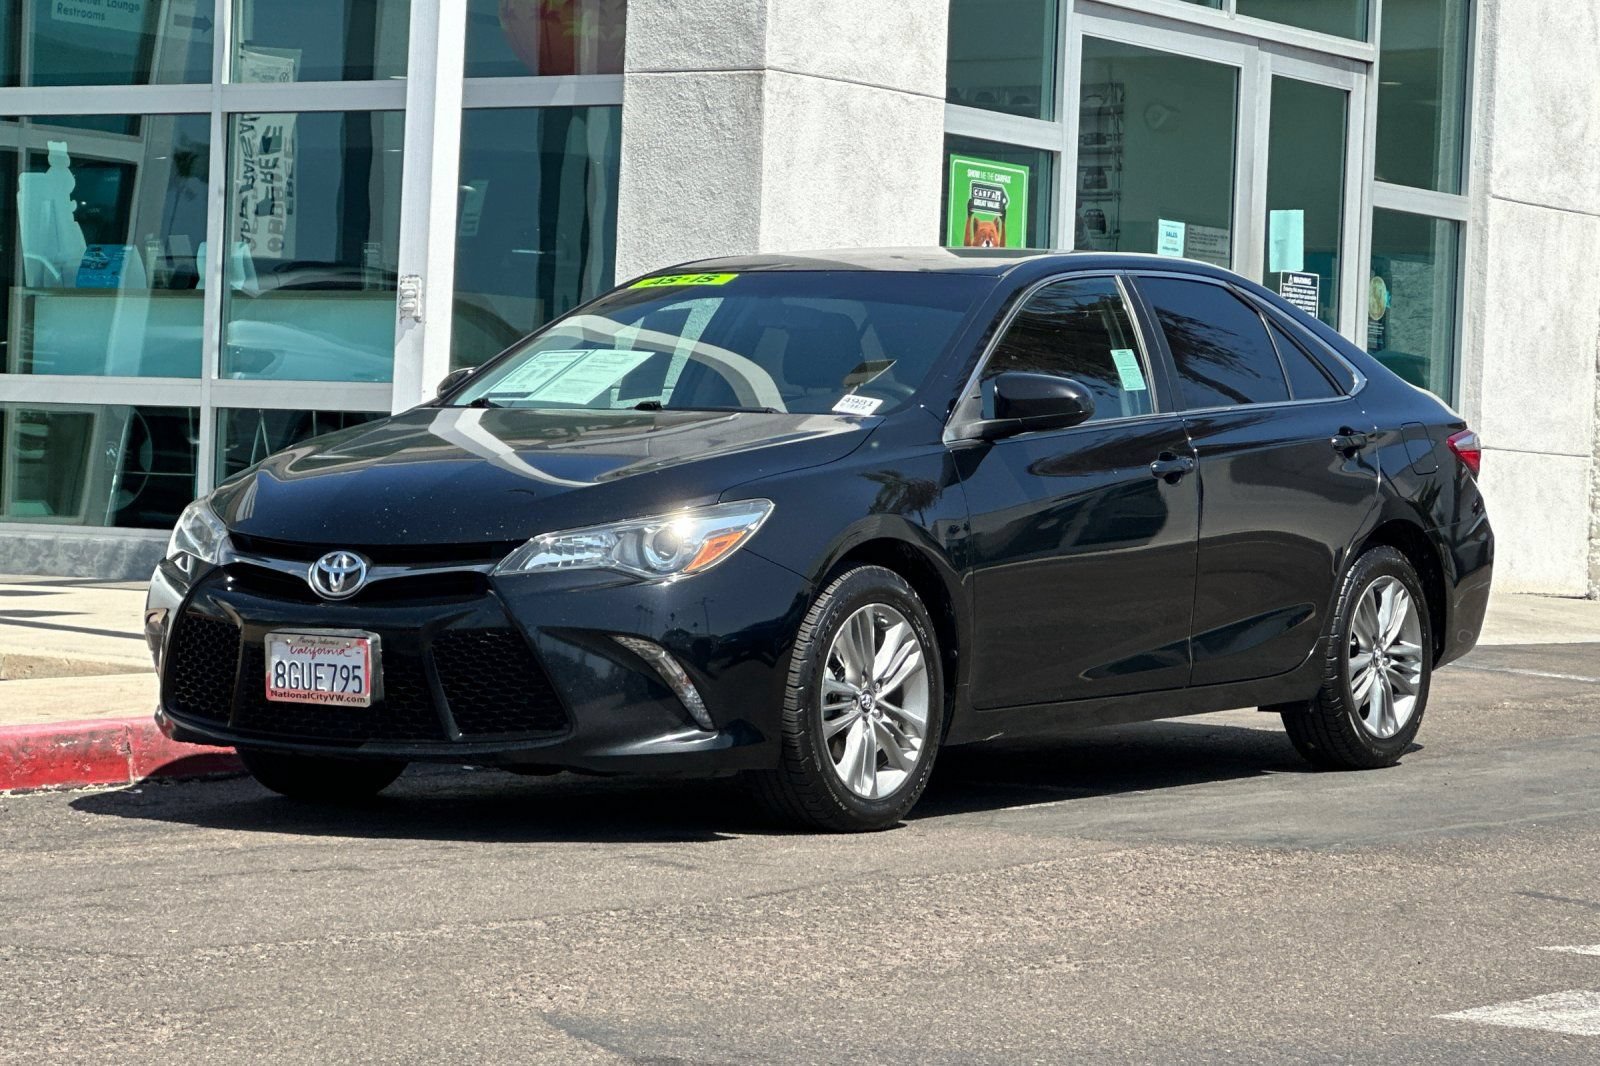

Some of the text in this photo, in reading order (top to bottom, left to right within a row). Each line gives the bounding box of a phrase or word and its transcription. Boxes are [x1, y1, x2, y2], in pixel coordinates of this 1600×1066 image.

[57, 2, 105, 21] Restrooms
[973, 188, 1001, 200] CARFAX
[290, 645, 352, 659] California
[274, 660, 363, 694] 8GUE795
[270, 690, 366, 703] NationalCityVW.com
